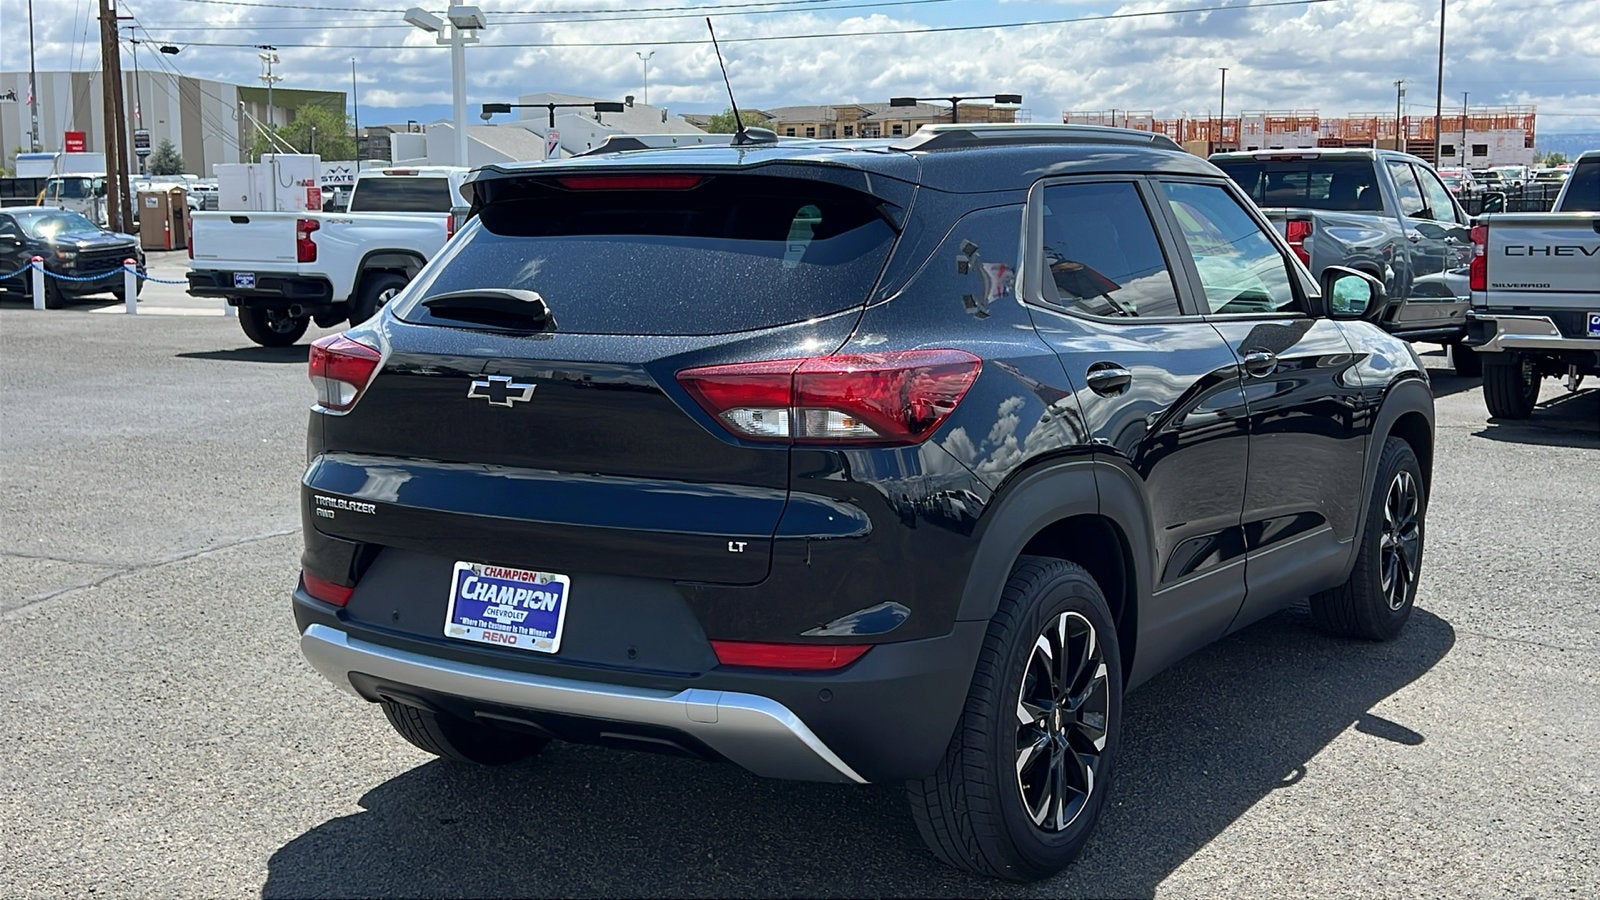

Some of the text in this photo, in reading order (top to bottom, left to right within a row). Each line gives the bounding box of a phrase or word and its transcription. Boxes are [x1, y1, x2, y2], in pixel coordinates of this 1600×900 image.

[314, 495, 376, 514] TRAILBLAZER
[316, 507, 335, 519] AWD
[728, 541, 748, 552] LT
[484, 567, 537, 582] CHAMPION
[461, 576, 558, 611] CHAMPION
[486, 607, 525, 620] CHEVROLET
[478, 619, 487, 628] The
[488, 621, 512, 632] Customer
[519, 626, 528, 635] The
[482, 631, 517, 644] RENO
